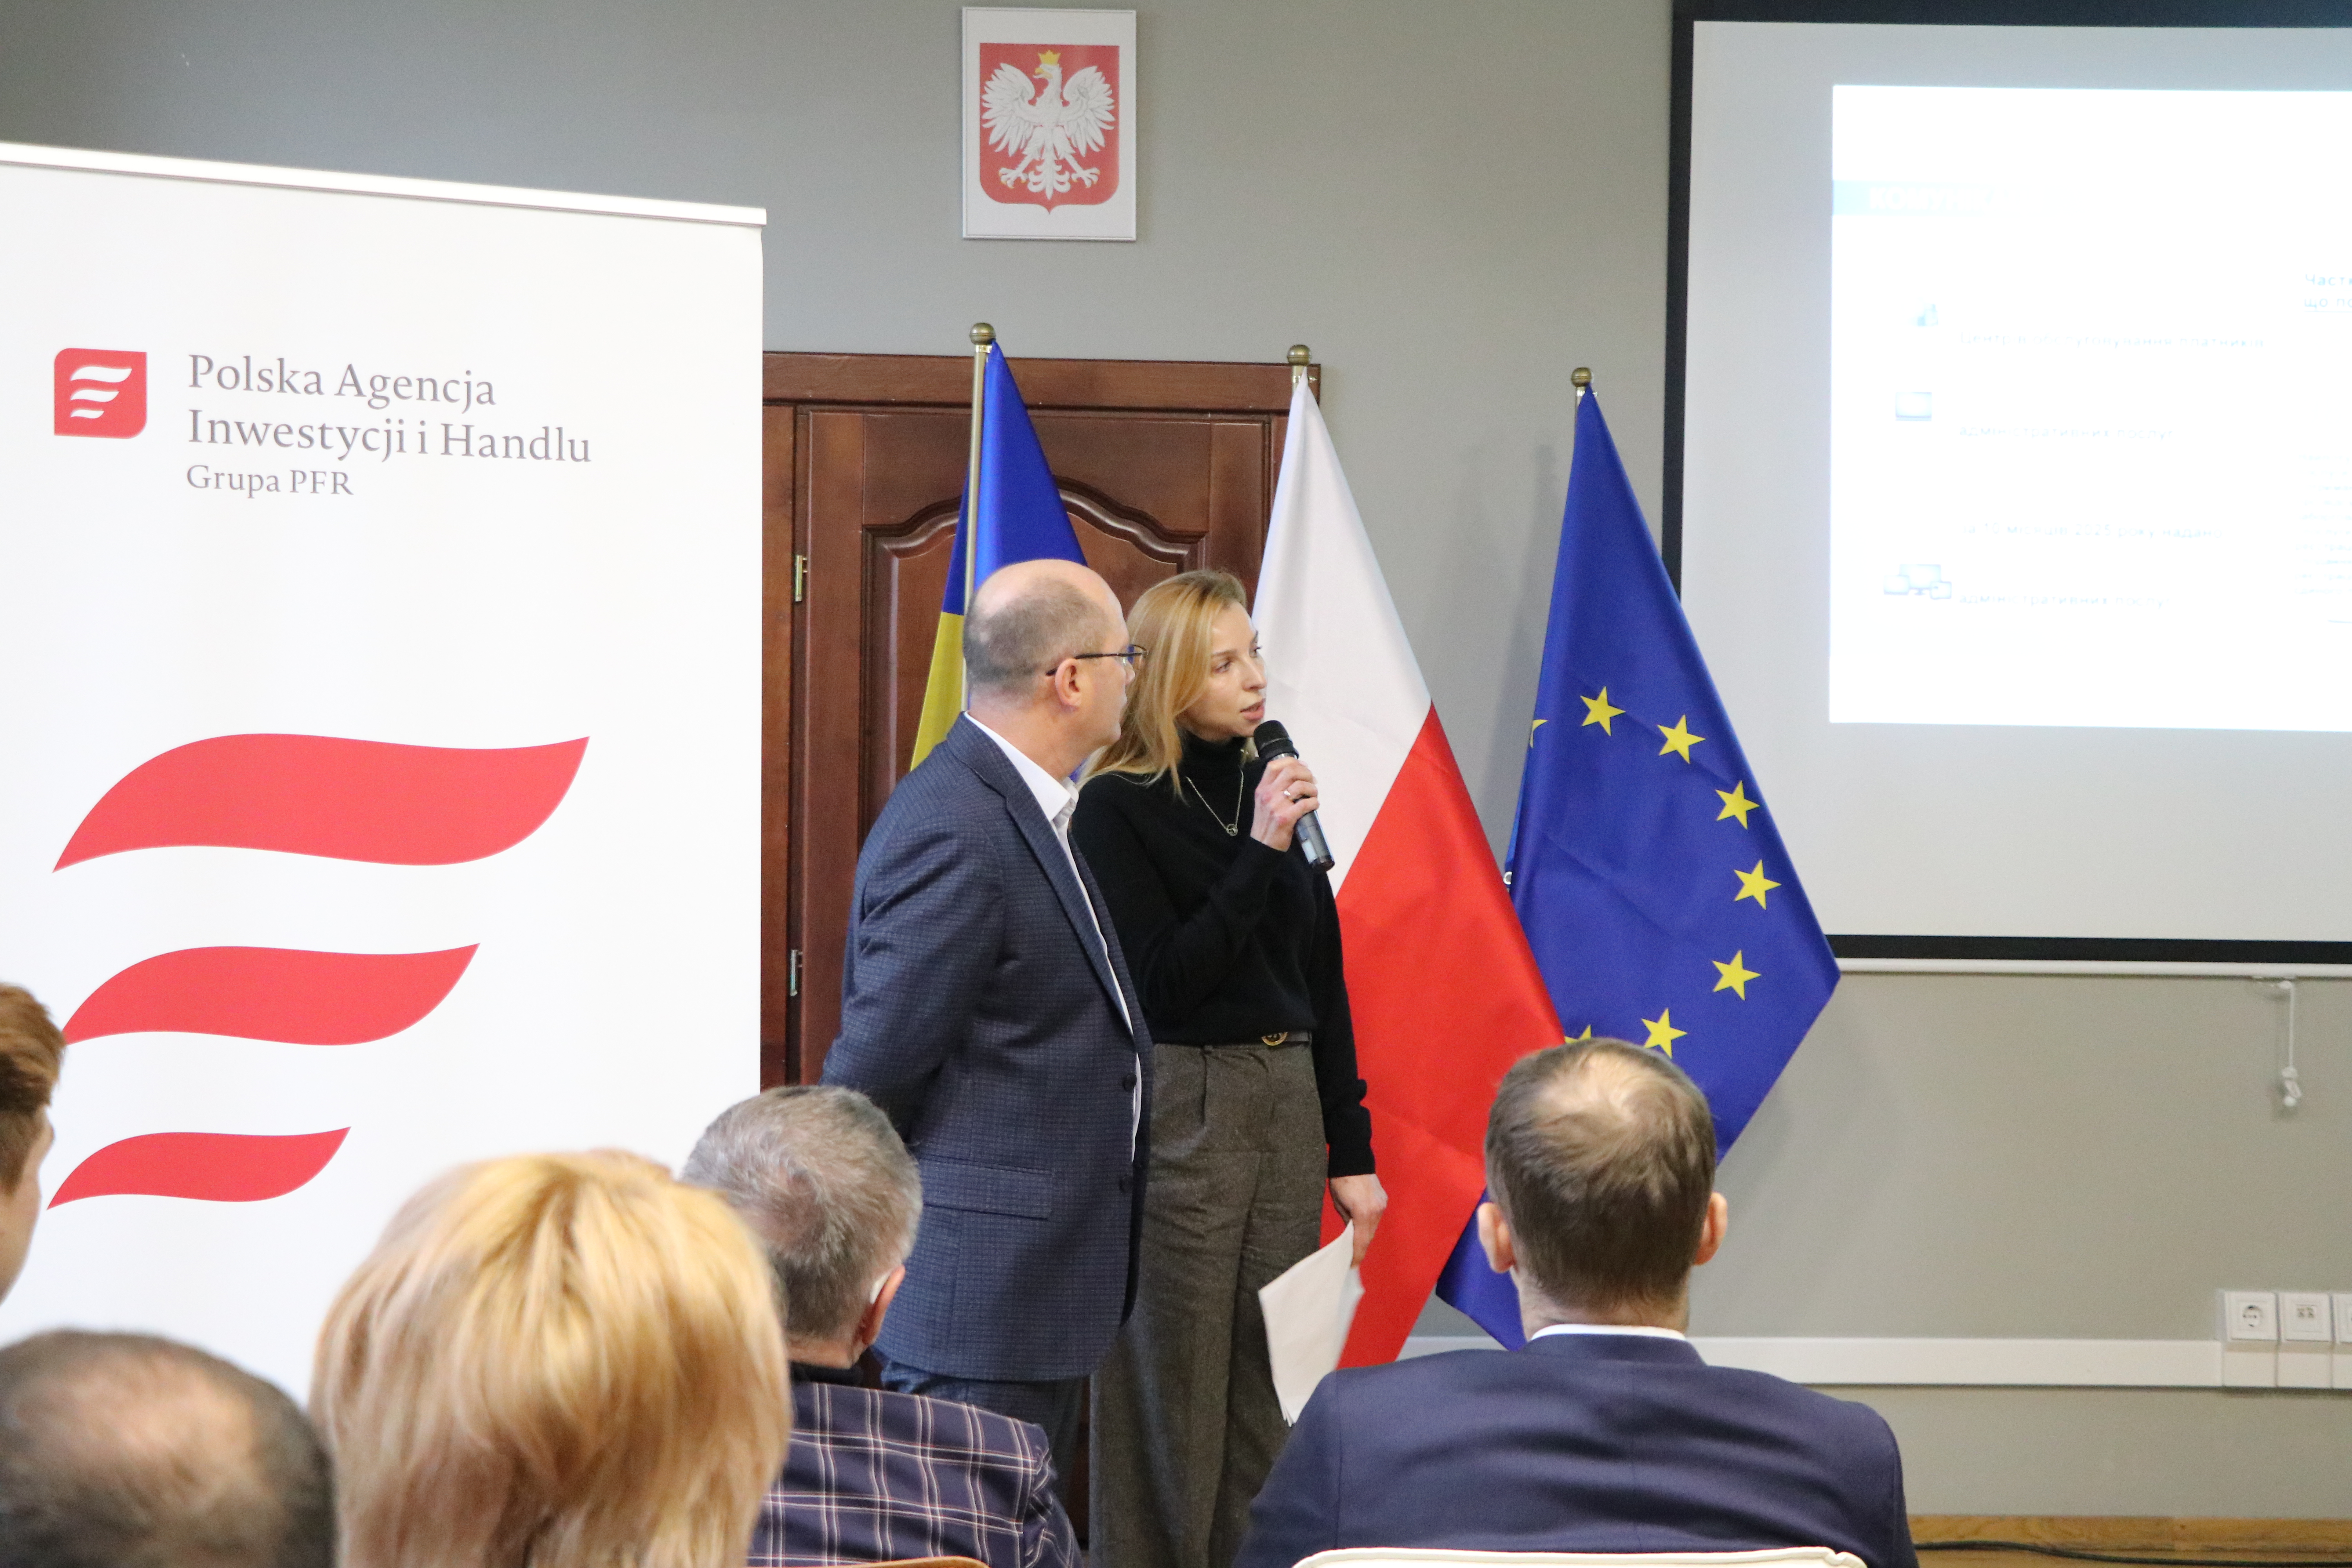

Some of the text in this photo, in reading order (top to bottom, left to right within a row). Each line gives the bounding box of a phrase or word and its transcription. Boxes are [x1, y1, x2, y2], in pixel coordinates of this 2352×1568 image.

[188, 354, 495, 412] Polska Agencja
[189, 409, 591, 462] Inwestycji i Handlu
[186, 465, 354, 499] Grupa PFR
